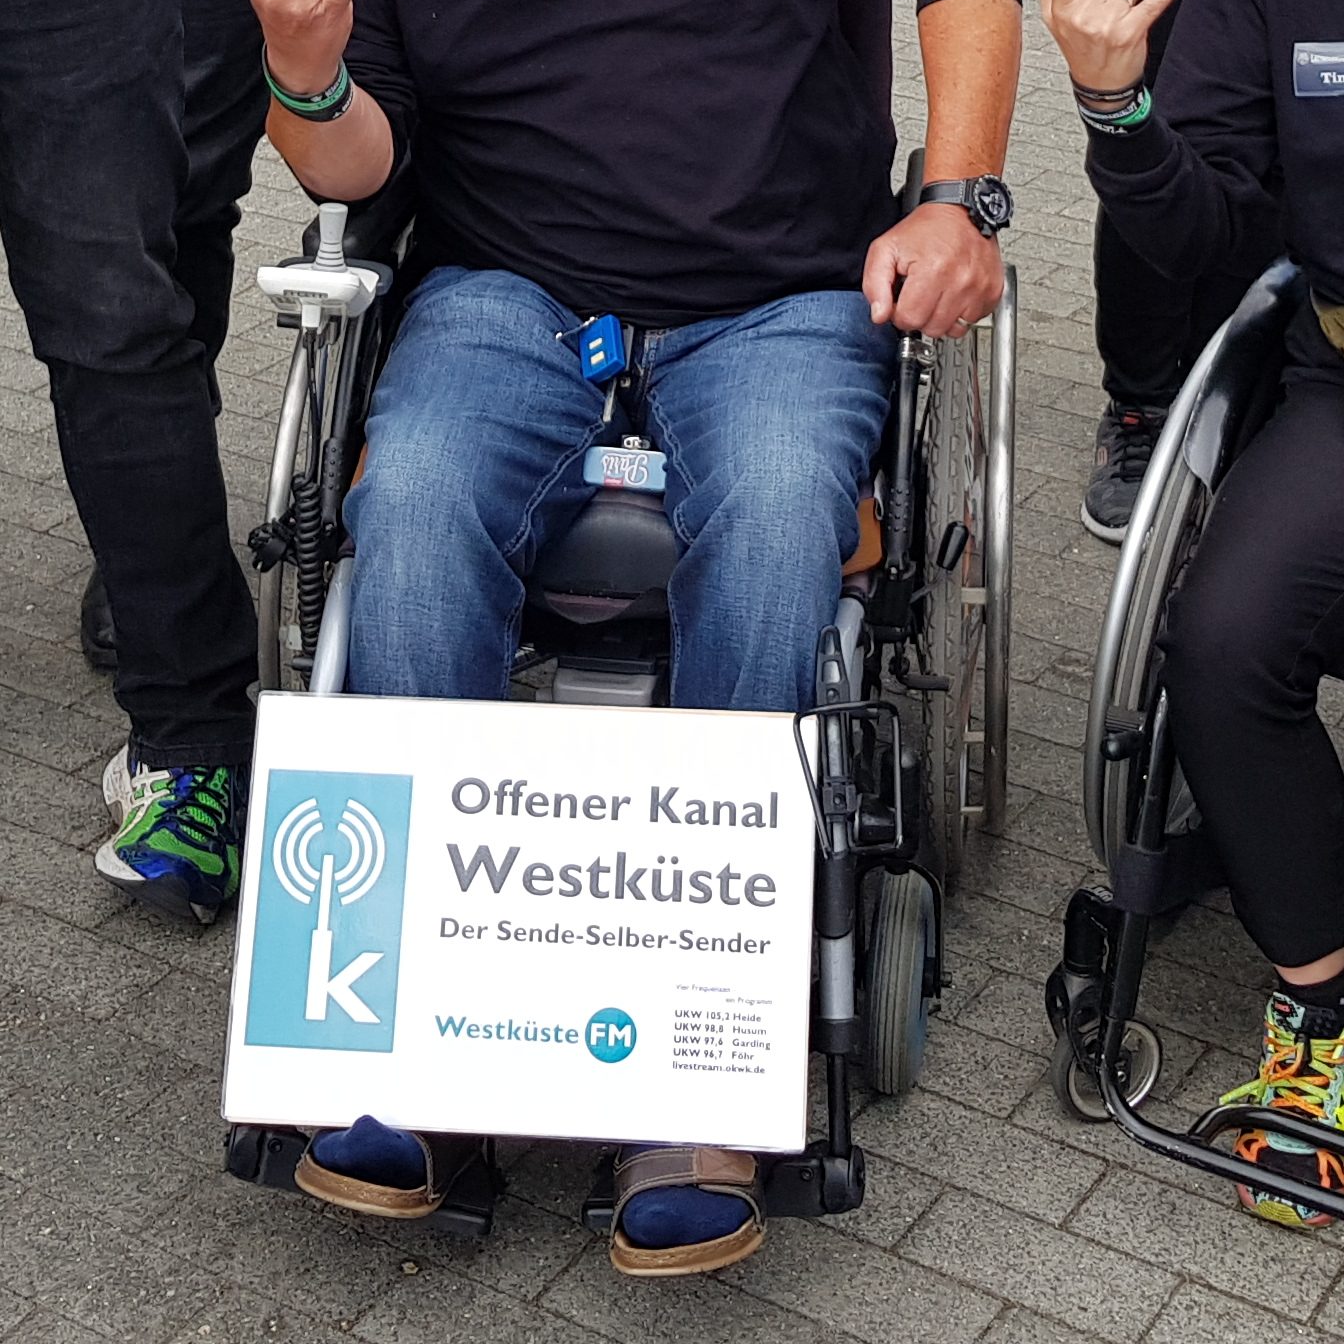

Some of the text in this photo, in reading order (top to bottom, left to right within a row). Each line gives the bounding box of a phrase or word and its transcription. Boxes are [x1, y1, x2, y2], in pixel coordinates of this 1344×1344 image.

[450, 776, 779, 830] Offener Kanal
[446, 842, 778, 909] Westküste
[439, 916, 772, 956] Der Sende-Selber-Sender
[674, 1009, 762, 1023] UKW 105,2 Heide
[434, 1012, 633, 1049] Westküste FM
[674, 1022, 702, 1032] UKW
[732, 1026, 767, 1036] Husum
[673, 1035, 771, 1051] UKW 97,6 Garding
[673, 1047, 755, 1061] UKW 96,7 Föhr
[672, 1060, 766, 1074] livestream.okwk.de
